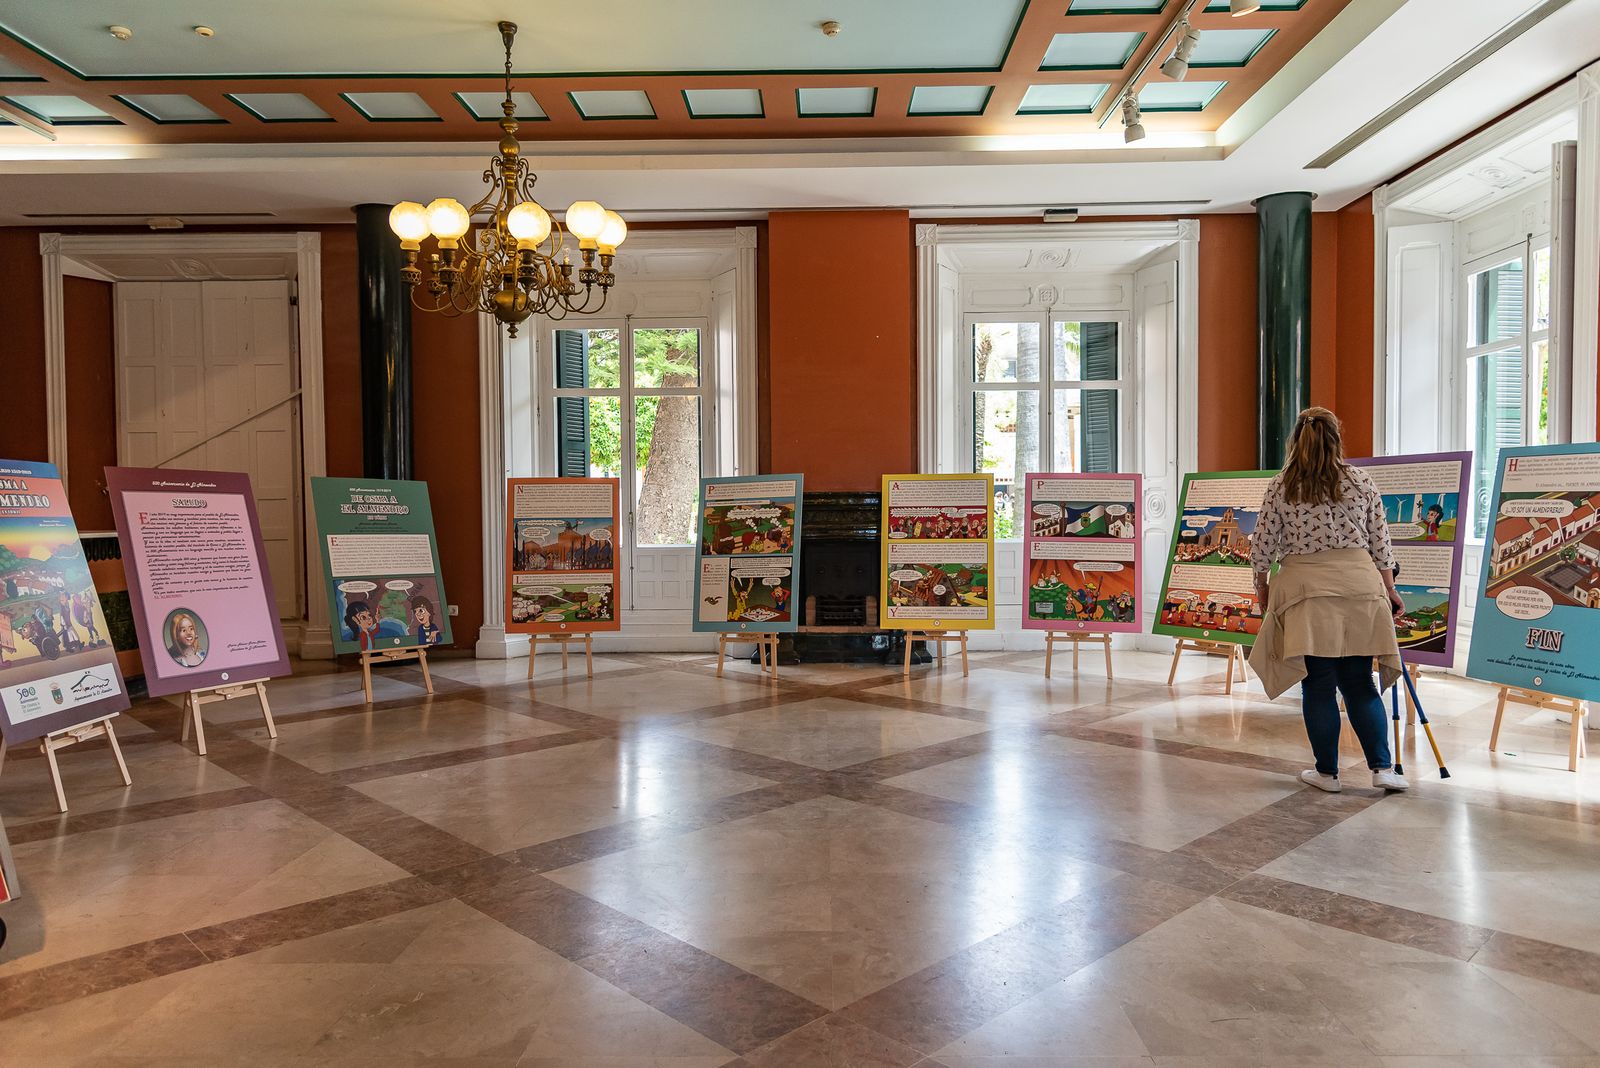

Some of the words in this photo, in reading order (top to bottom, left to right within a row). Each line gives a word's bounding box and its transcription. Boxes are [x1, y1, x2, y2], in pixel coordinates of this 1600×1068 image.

[20, 480, 28, 490] A
[172, 498, 208, 508] SALUDO
[350, 494, 364, 503] DE
[364, 494, 390, 504] OSMA
[390, 496, 398, 504] A
[340, 504, 356, 514] EL
[356, 504, 410, 514] ALMENDRO
[1525, 626, 1565, 653] FIN
